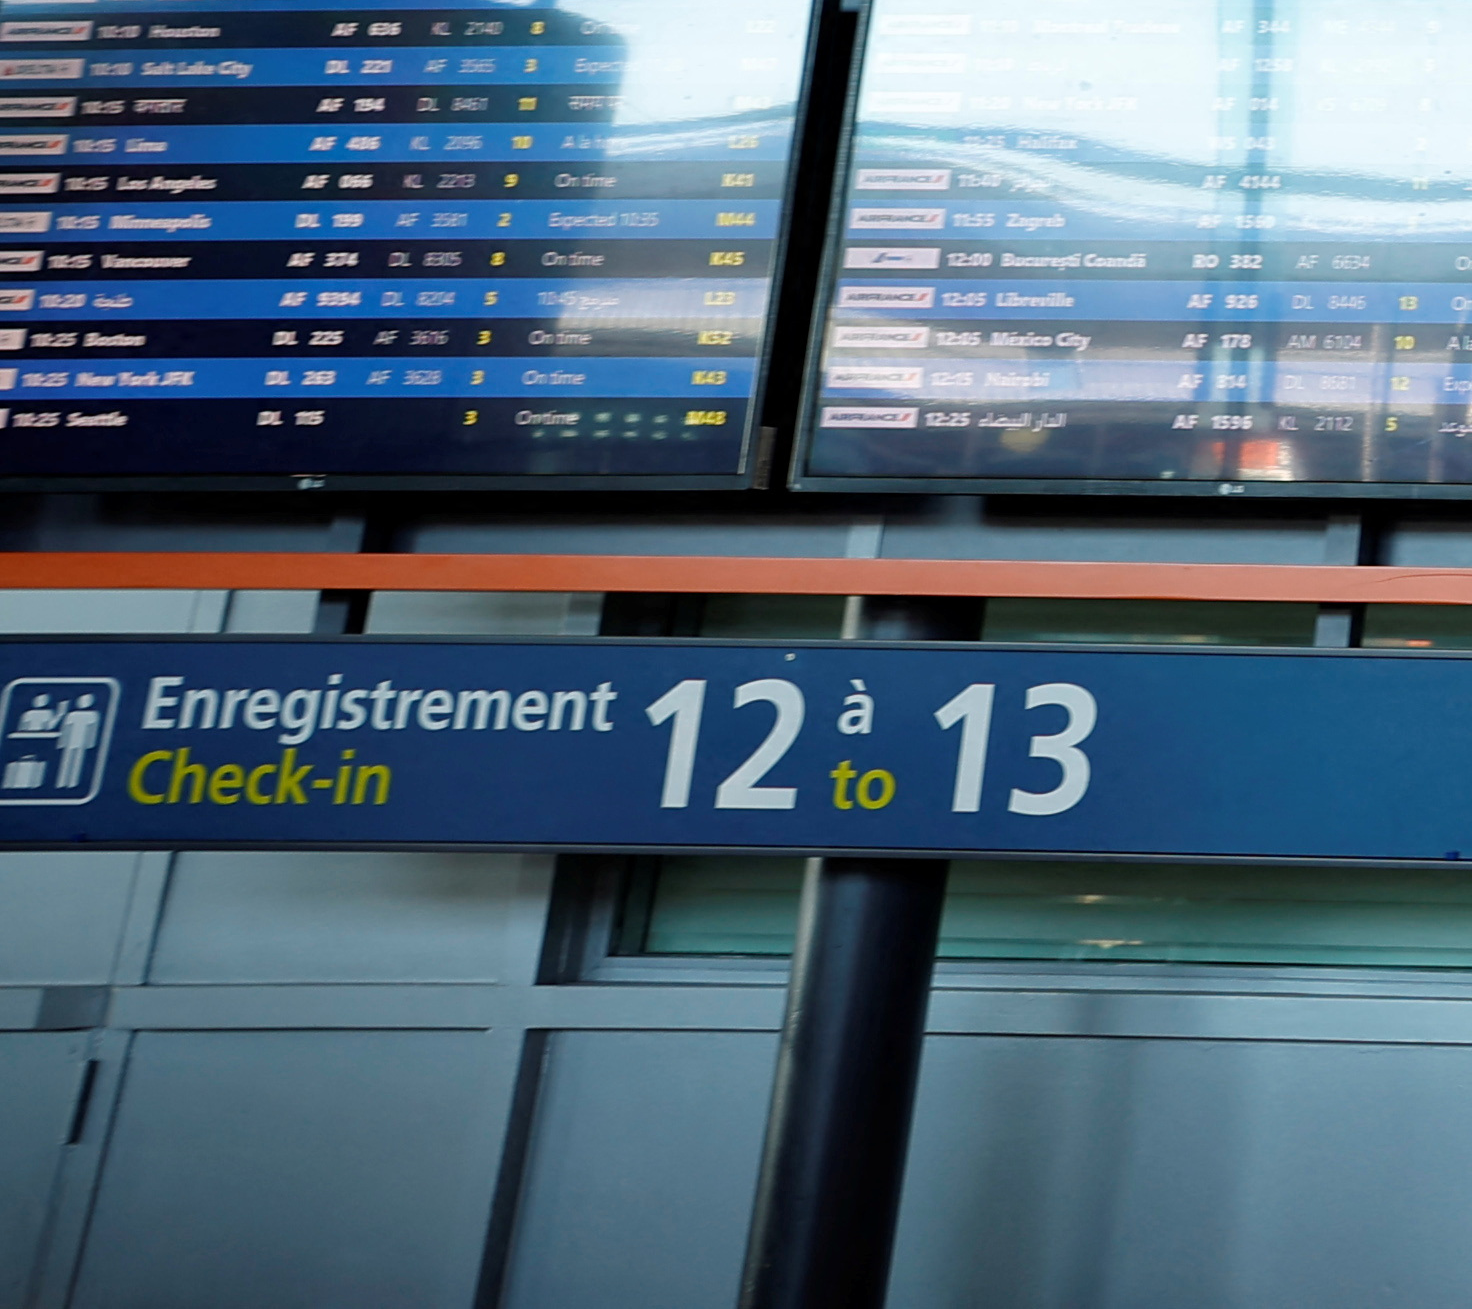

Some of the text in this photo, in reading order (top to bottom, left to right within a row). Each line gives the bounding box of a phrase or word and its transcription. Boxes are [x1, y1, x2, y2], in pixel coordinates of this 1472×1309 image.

[128, 746, 897, 811] Check-in to
[141, 672, 1098, 817] Enregistrement 12 à 13
